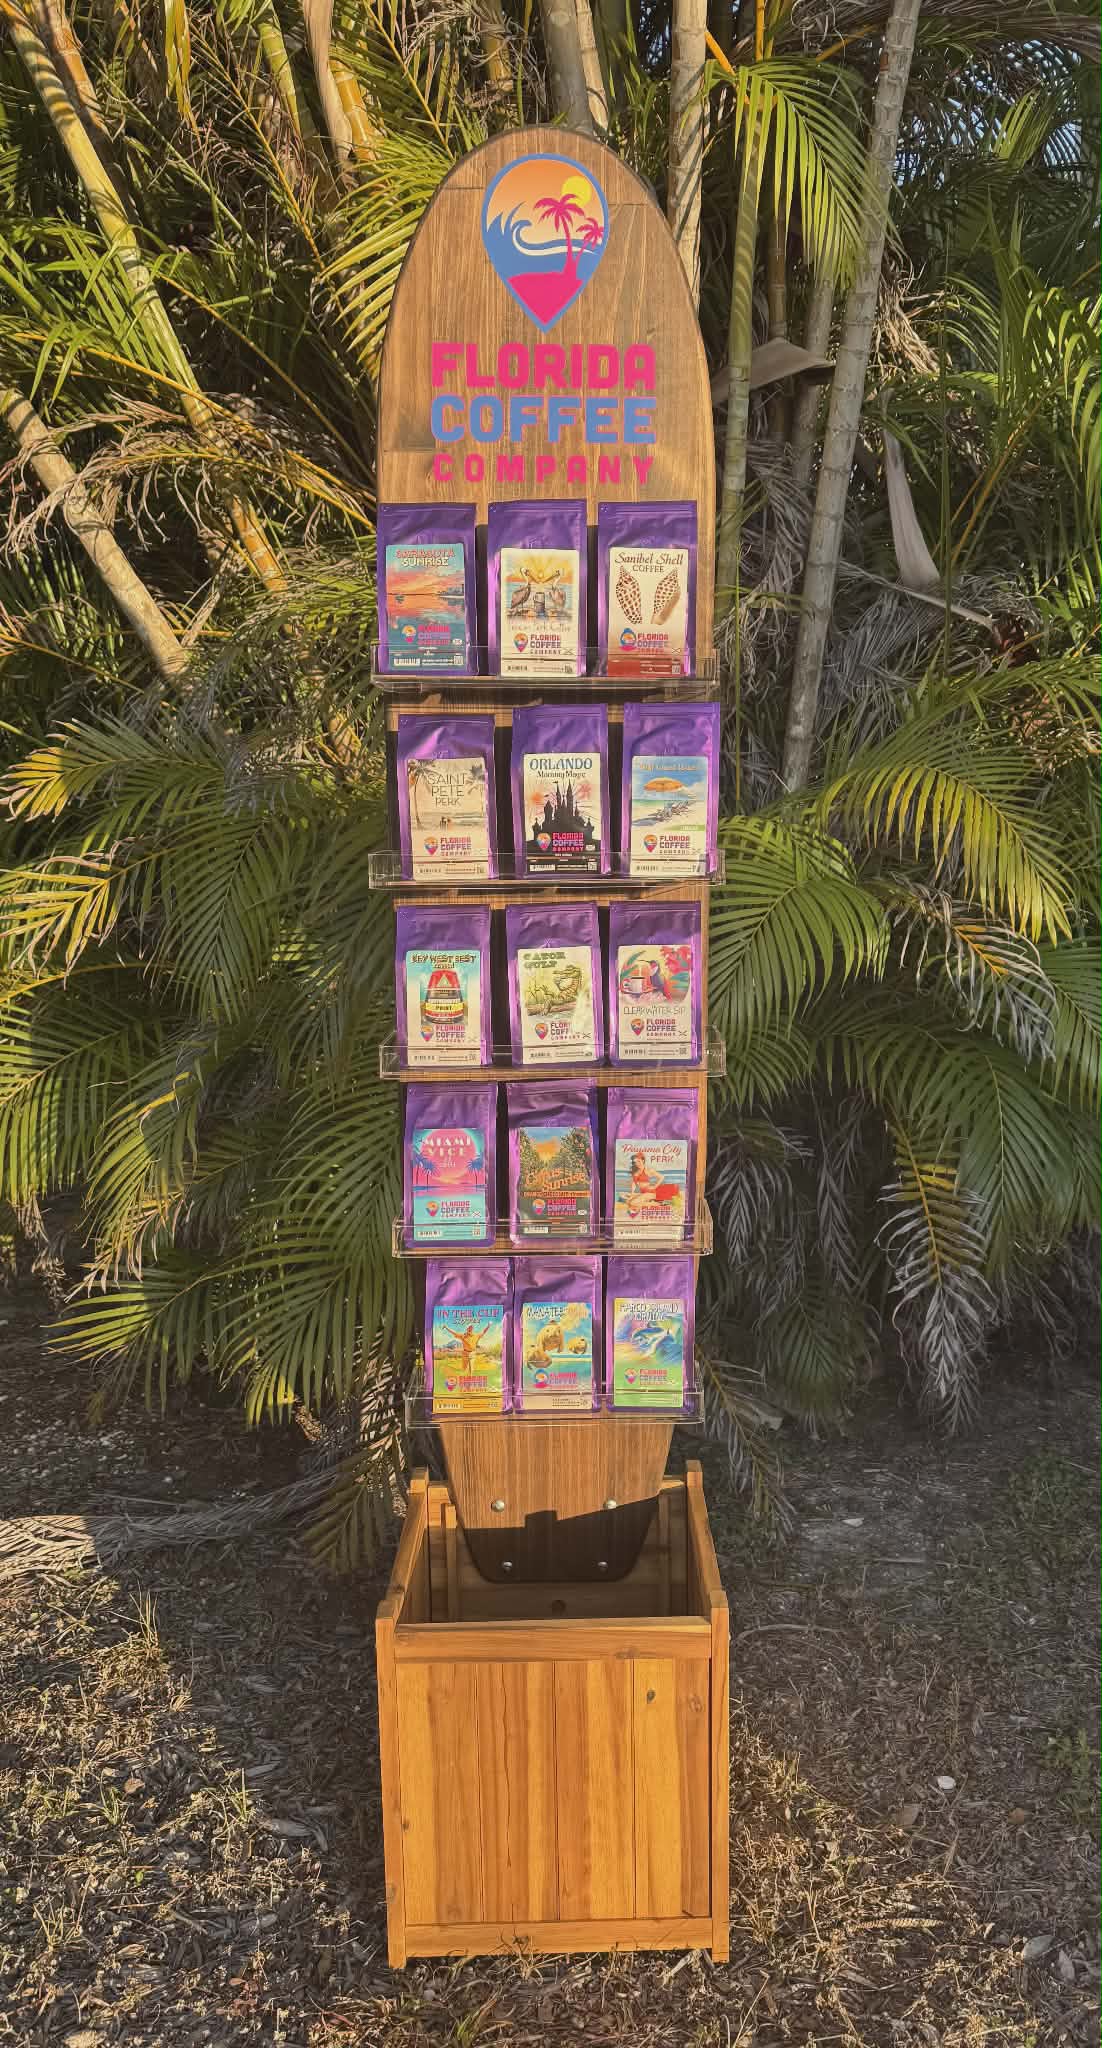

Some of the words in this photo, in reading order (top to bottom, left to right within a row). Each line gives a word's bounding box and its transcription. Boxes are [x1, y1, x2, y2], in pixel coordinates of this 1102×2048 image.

[432, 342, 657, 390] FLORIDA
[430, 394, 658, 444] COFFEE
[432, 453, 655, 485] COMPANY
[615, 552, 654, 564] Sanibel
[655, 552, 684, 566] Shell
[632, 565, 665, 573] COFFEE
[529, 757, 593, 770] ORLANDO
[427, 773, 467, 785] SAINT
[431, 785, 465, 797] PETE
[435, 797, 461, 807] PERK
[552, 832, 584, 840] FLORIDA
[424, 1136, 472, 1146] MIAMI
[428, 1147, 465, 1158] VICE
[622, 1144, 661, 1154] Panama
[662, 1144, 682, 1156] City
[650, 1155, 674, 1163] PERK
